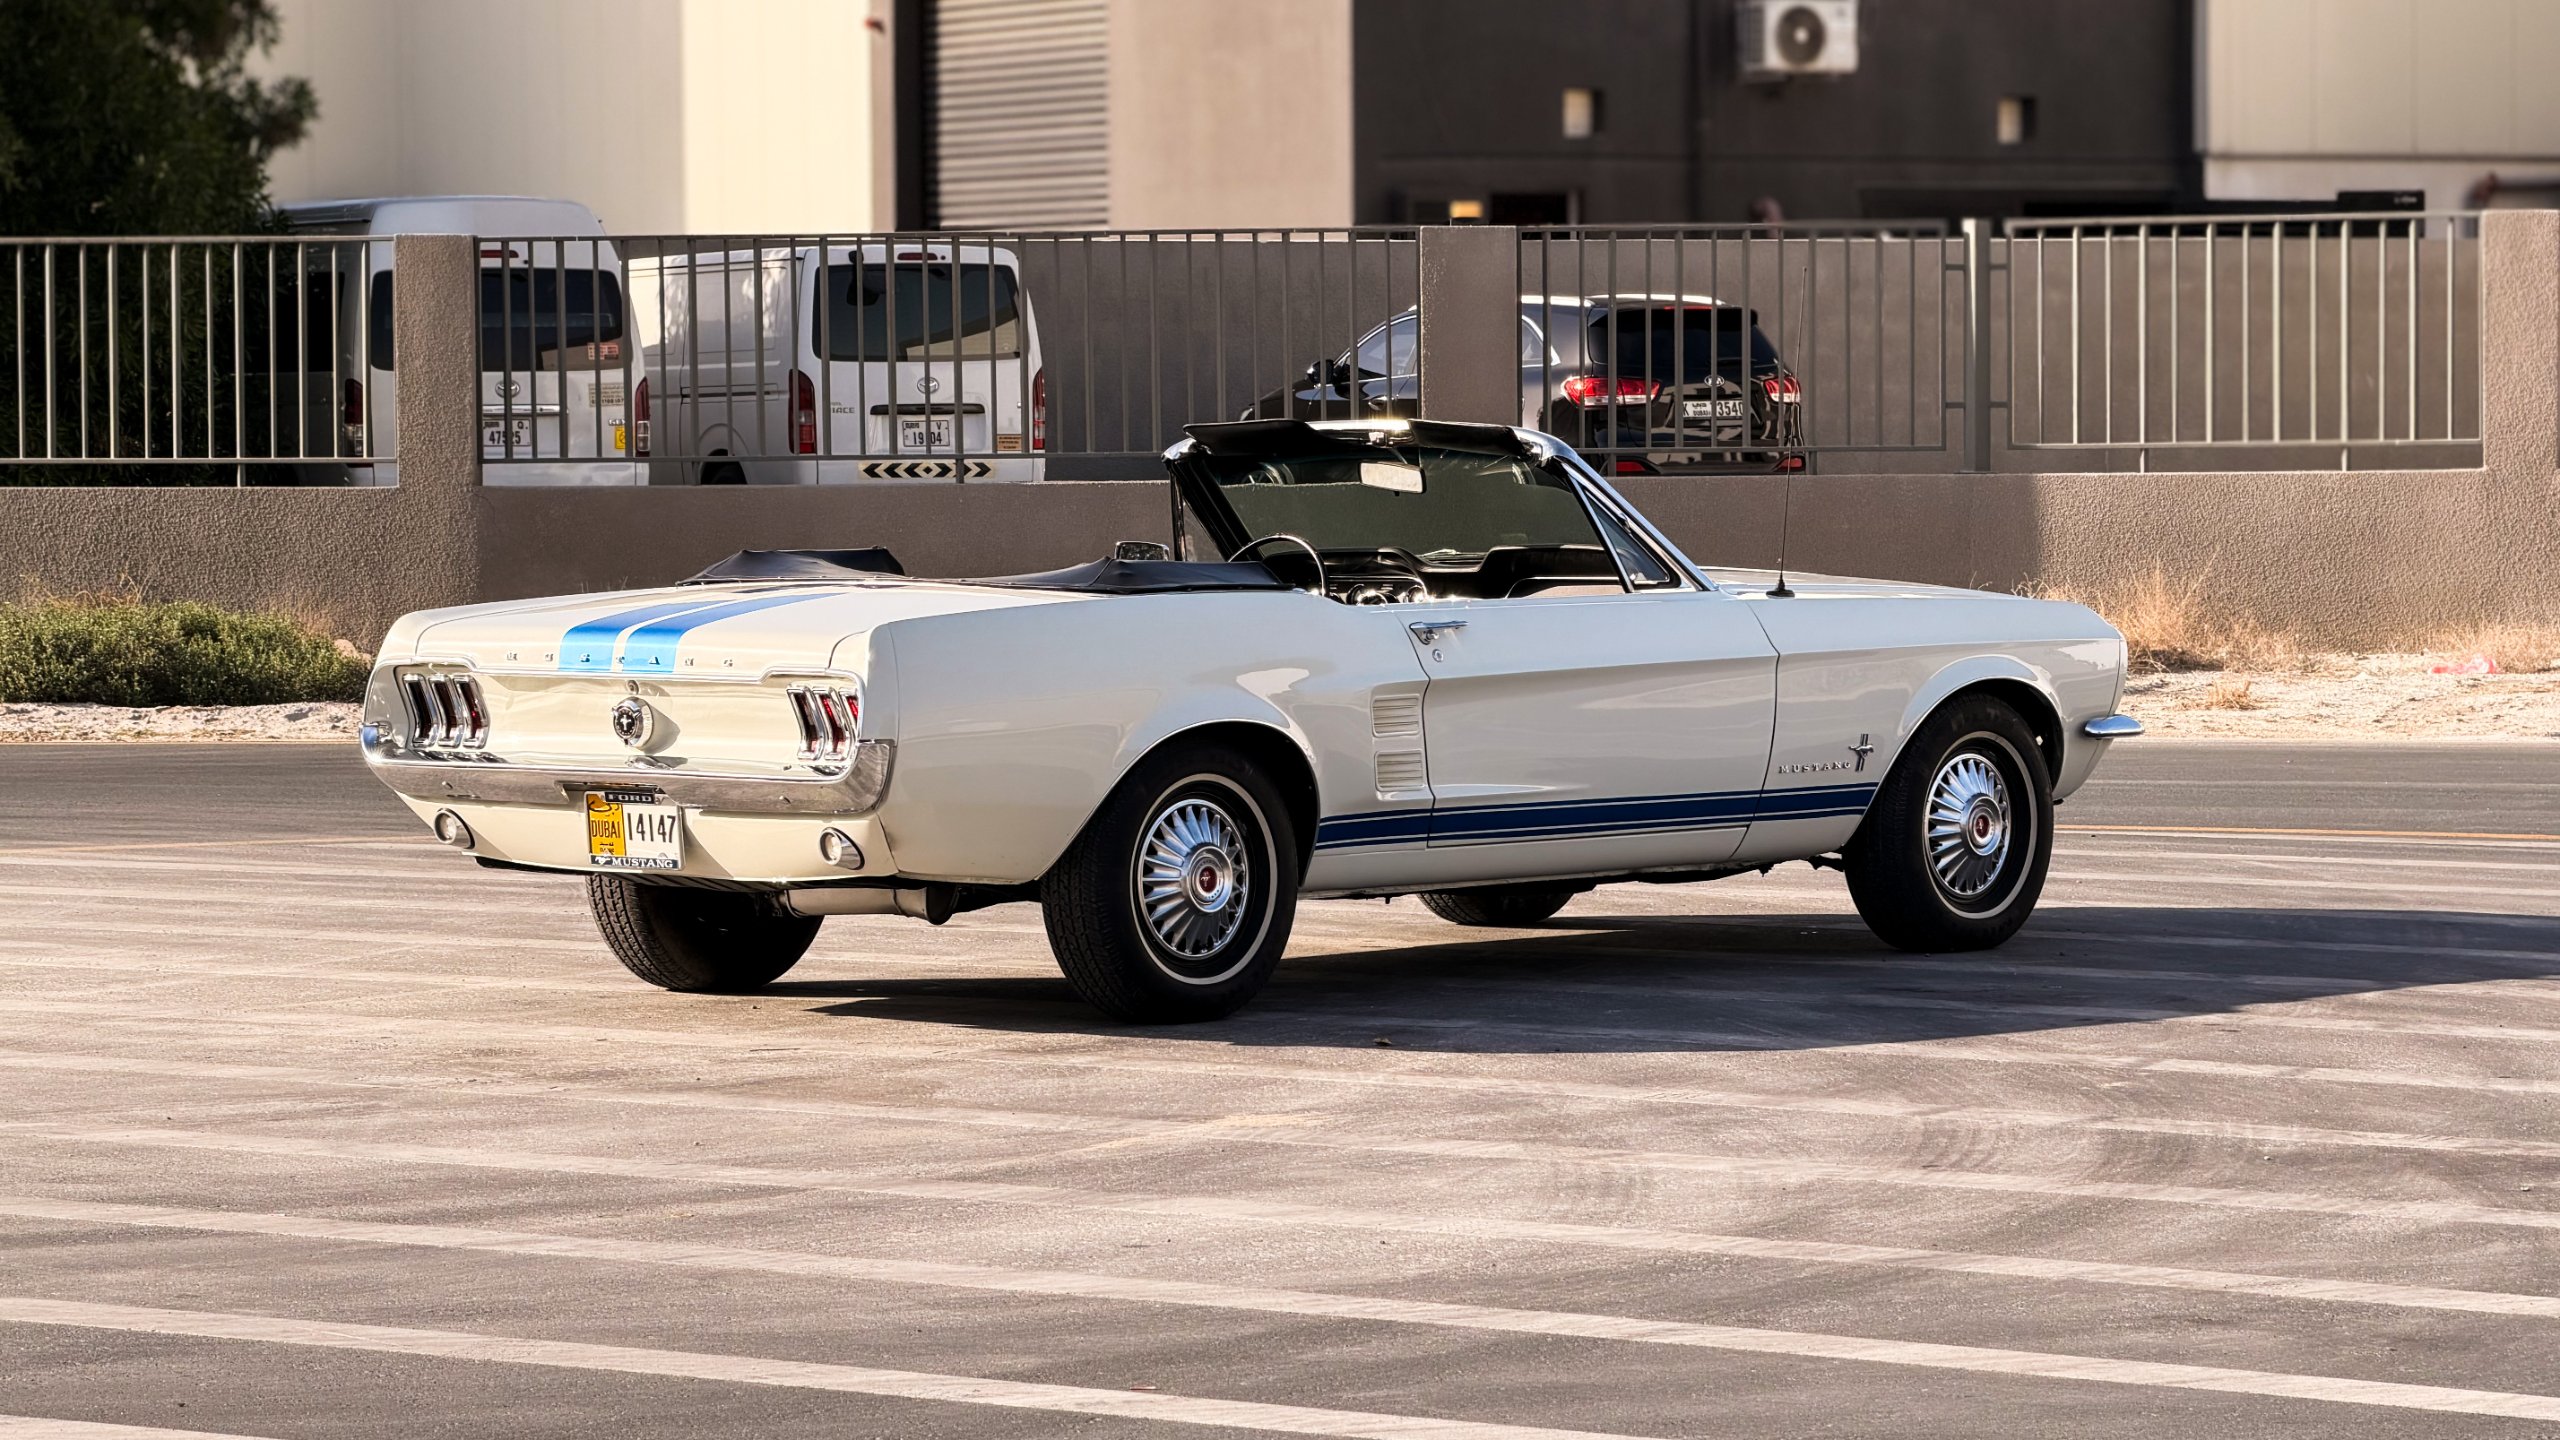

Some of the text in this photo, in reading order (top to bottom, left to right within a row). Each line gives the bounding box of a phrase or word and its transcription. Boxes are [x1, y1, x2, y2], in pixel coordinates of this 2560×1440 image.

[936, 422, 942, 430] V
[489, 430, 521, 445] 4755
[1779, 761, 1851, 774] MUSTANG
[608, 794, 652, 802] FORD
[591, 820, 621, 839] DUBAI
[627, 812, 676, 843] 14147
[612, 857, 674, 868] MUSTANG
